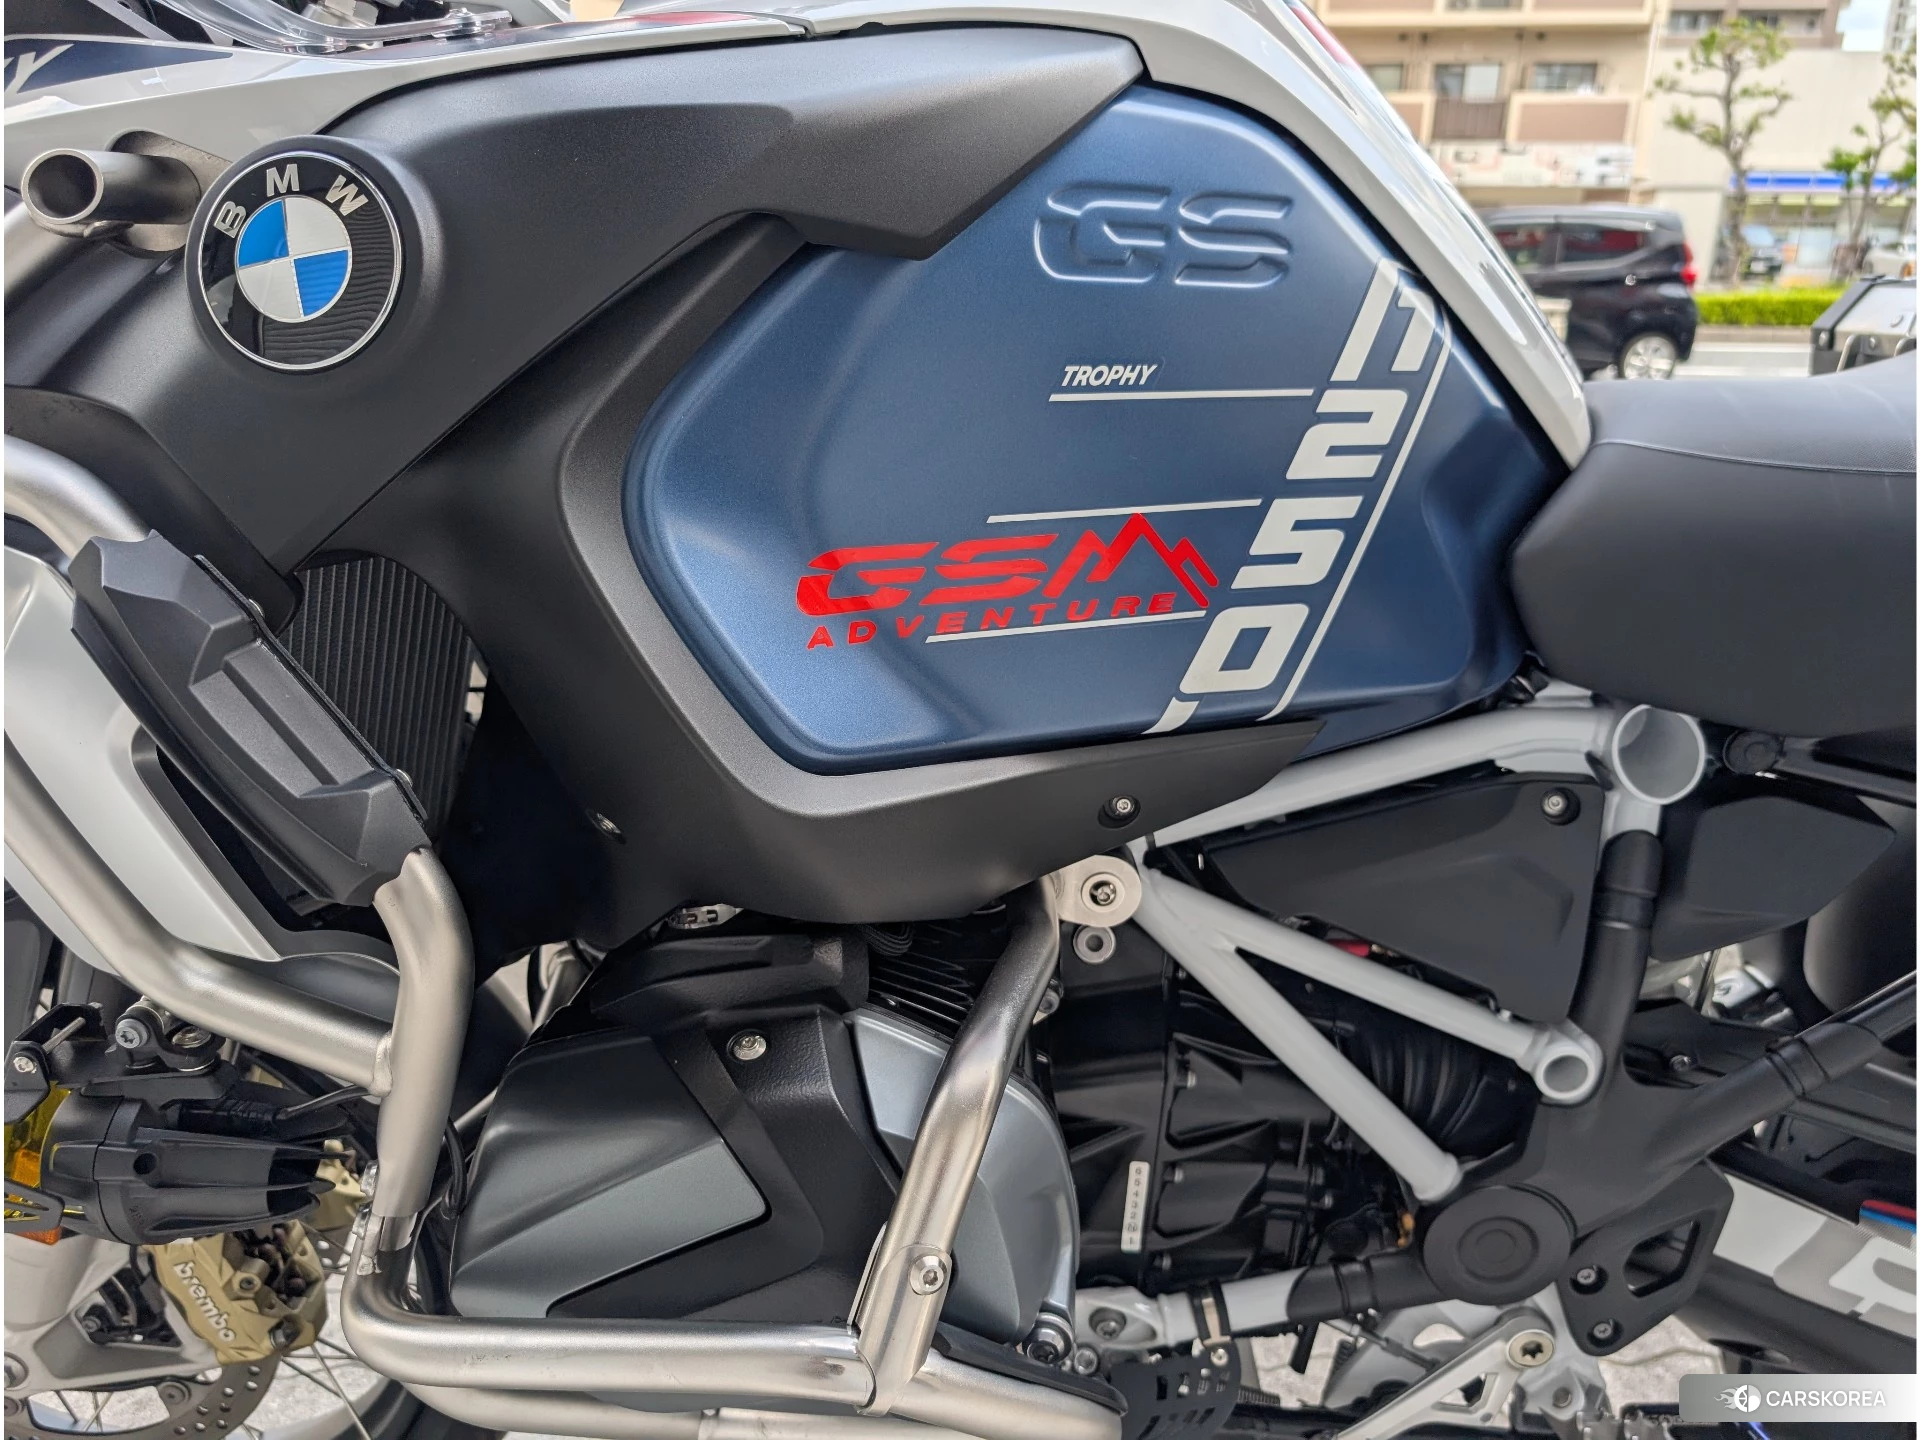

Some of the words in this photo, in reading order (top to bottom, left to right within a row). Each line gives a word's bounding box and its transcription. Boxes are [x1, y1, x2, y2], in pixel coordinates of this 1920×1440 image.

[213, 163, 369, 238] BMW
[1034, 182, 1294, 289] GS
[1061, 365, 1158, 387] TROPHY
[807, 591, 1177, 650] ADVENTURE
[174, 1261, 236, 1342] brembo
